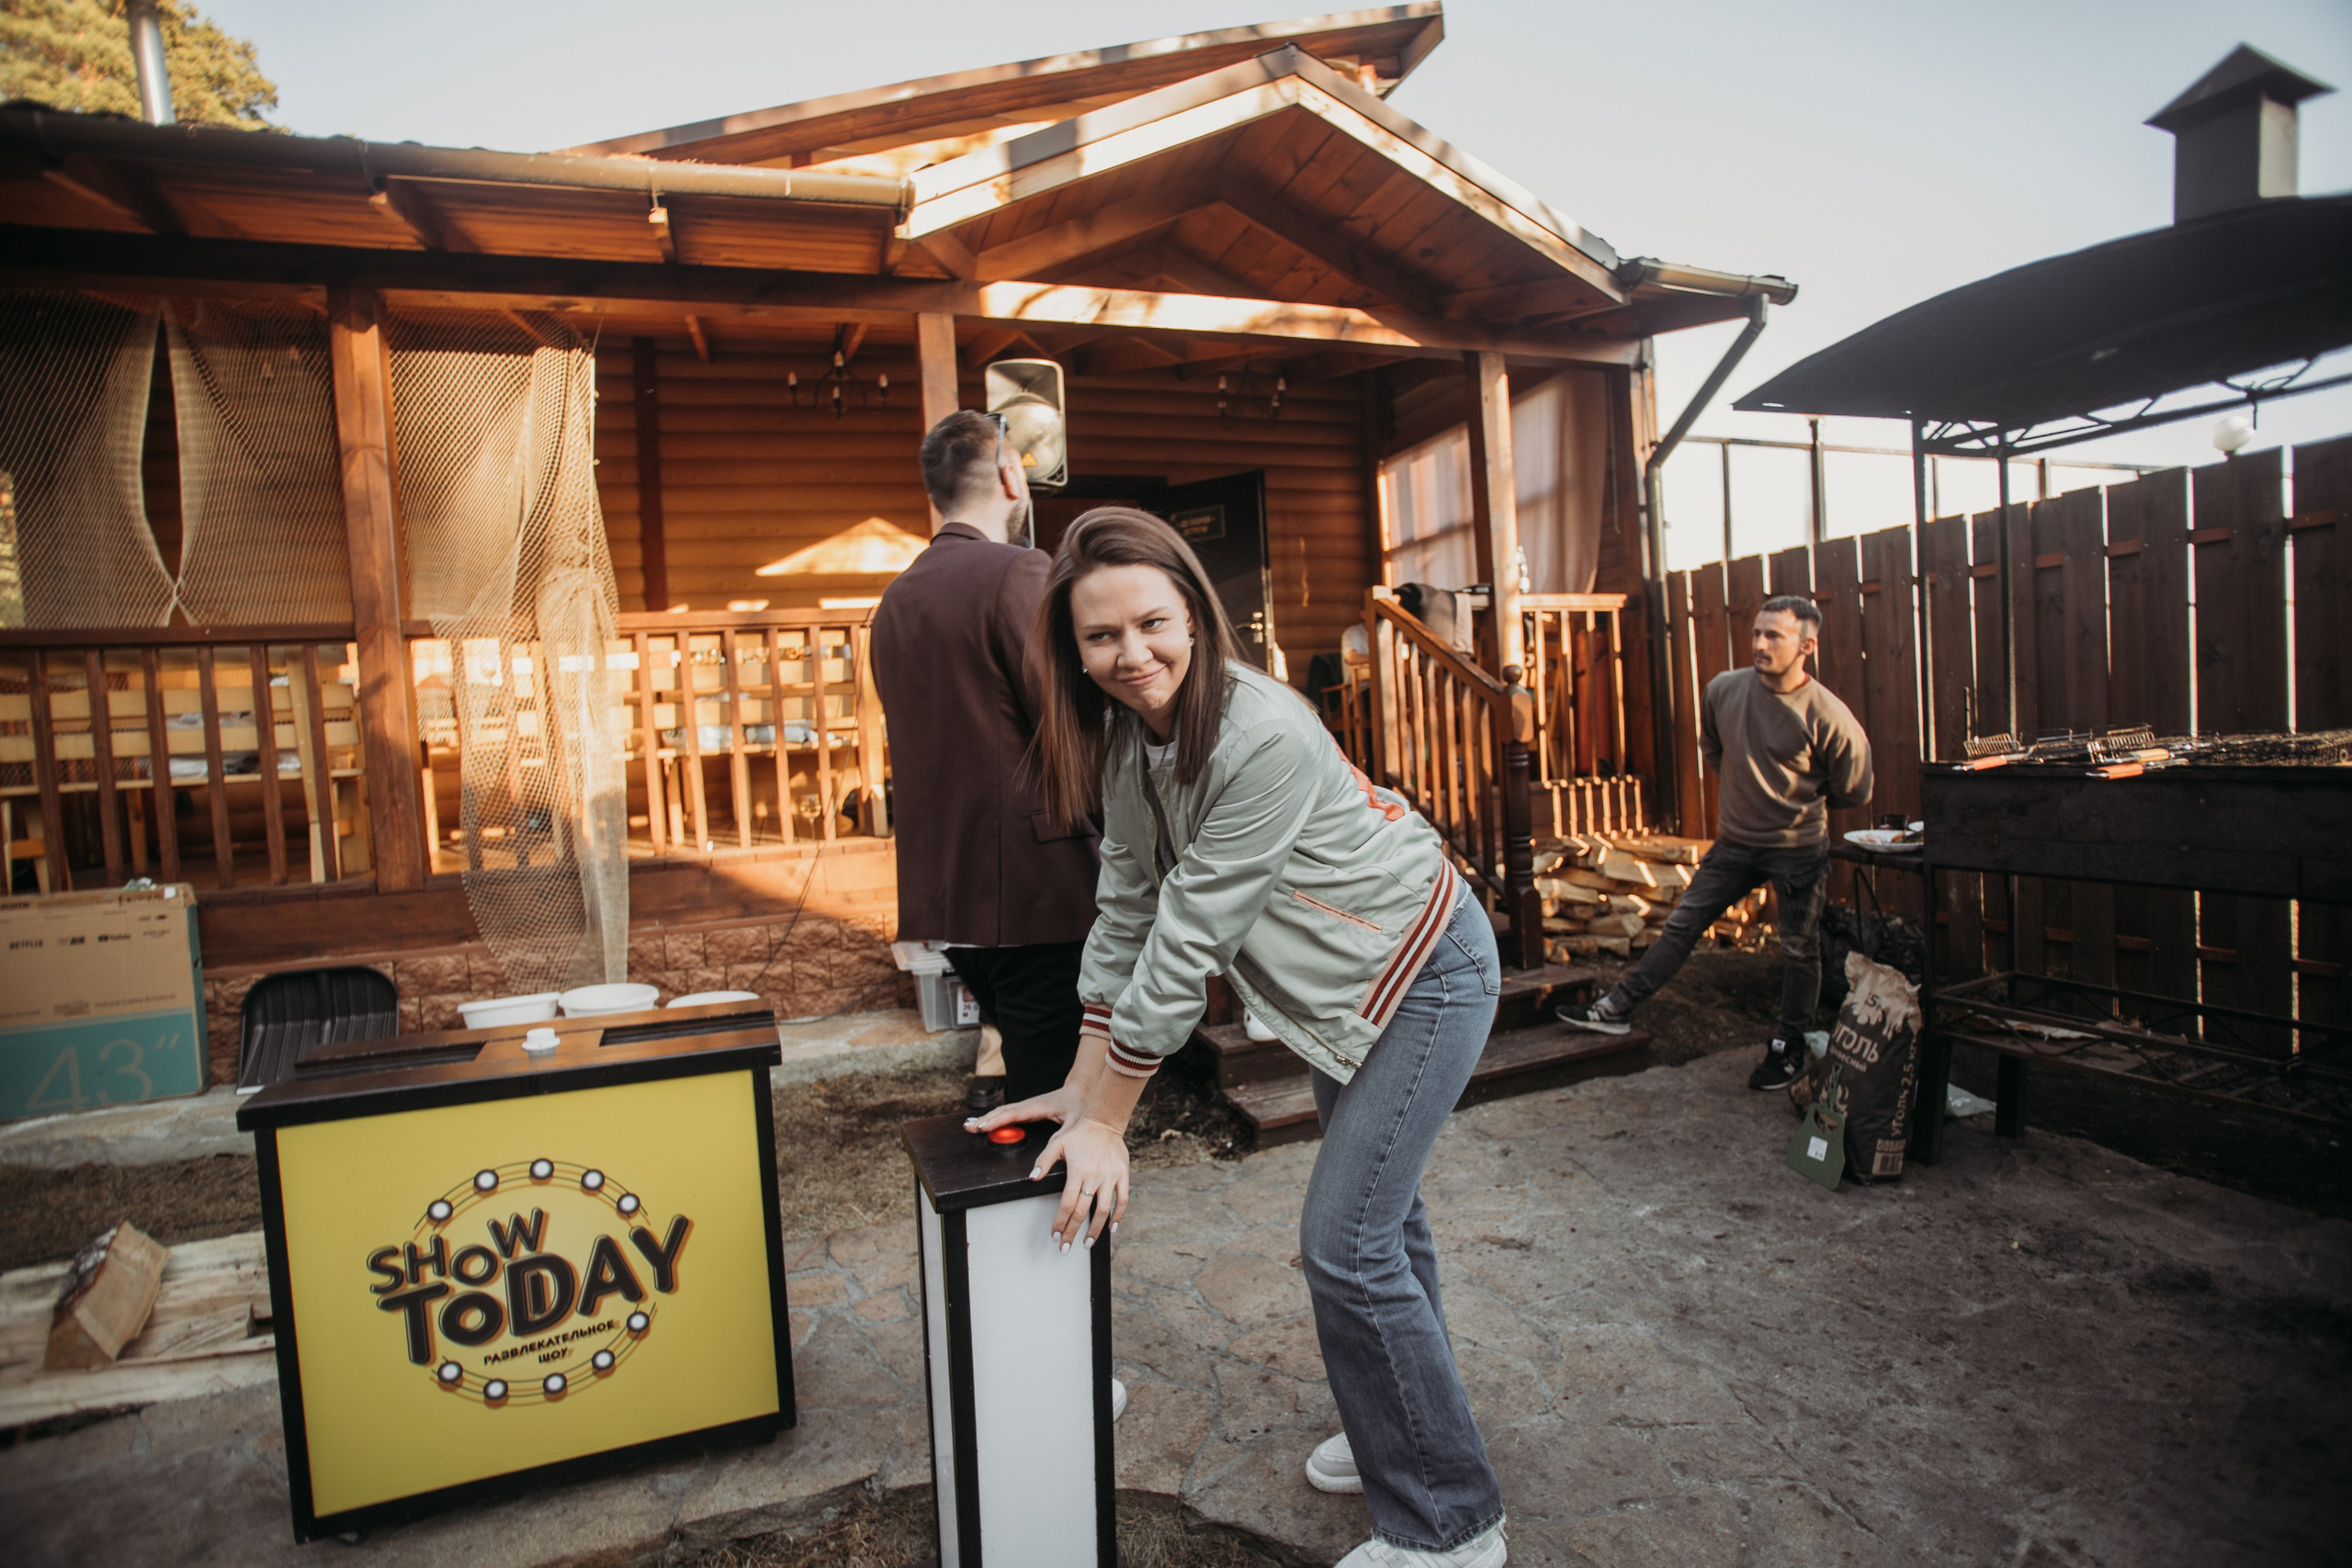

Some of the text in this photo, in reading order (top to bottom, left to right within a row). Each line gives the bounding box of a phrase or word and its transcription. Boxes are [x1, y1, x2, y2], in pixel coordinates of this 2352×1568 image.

[9, 938, 43, 951] NETFLIX
[367, 1207, 548, 1296] SHOW
[376, 1213, 695, 1367] TODAY
[483, 1319, 616, 1366] РАЗВЛЕКАТЕЛЬНОЕ
[537, 1347, 570, 1365] ШОУ
